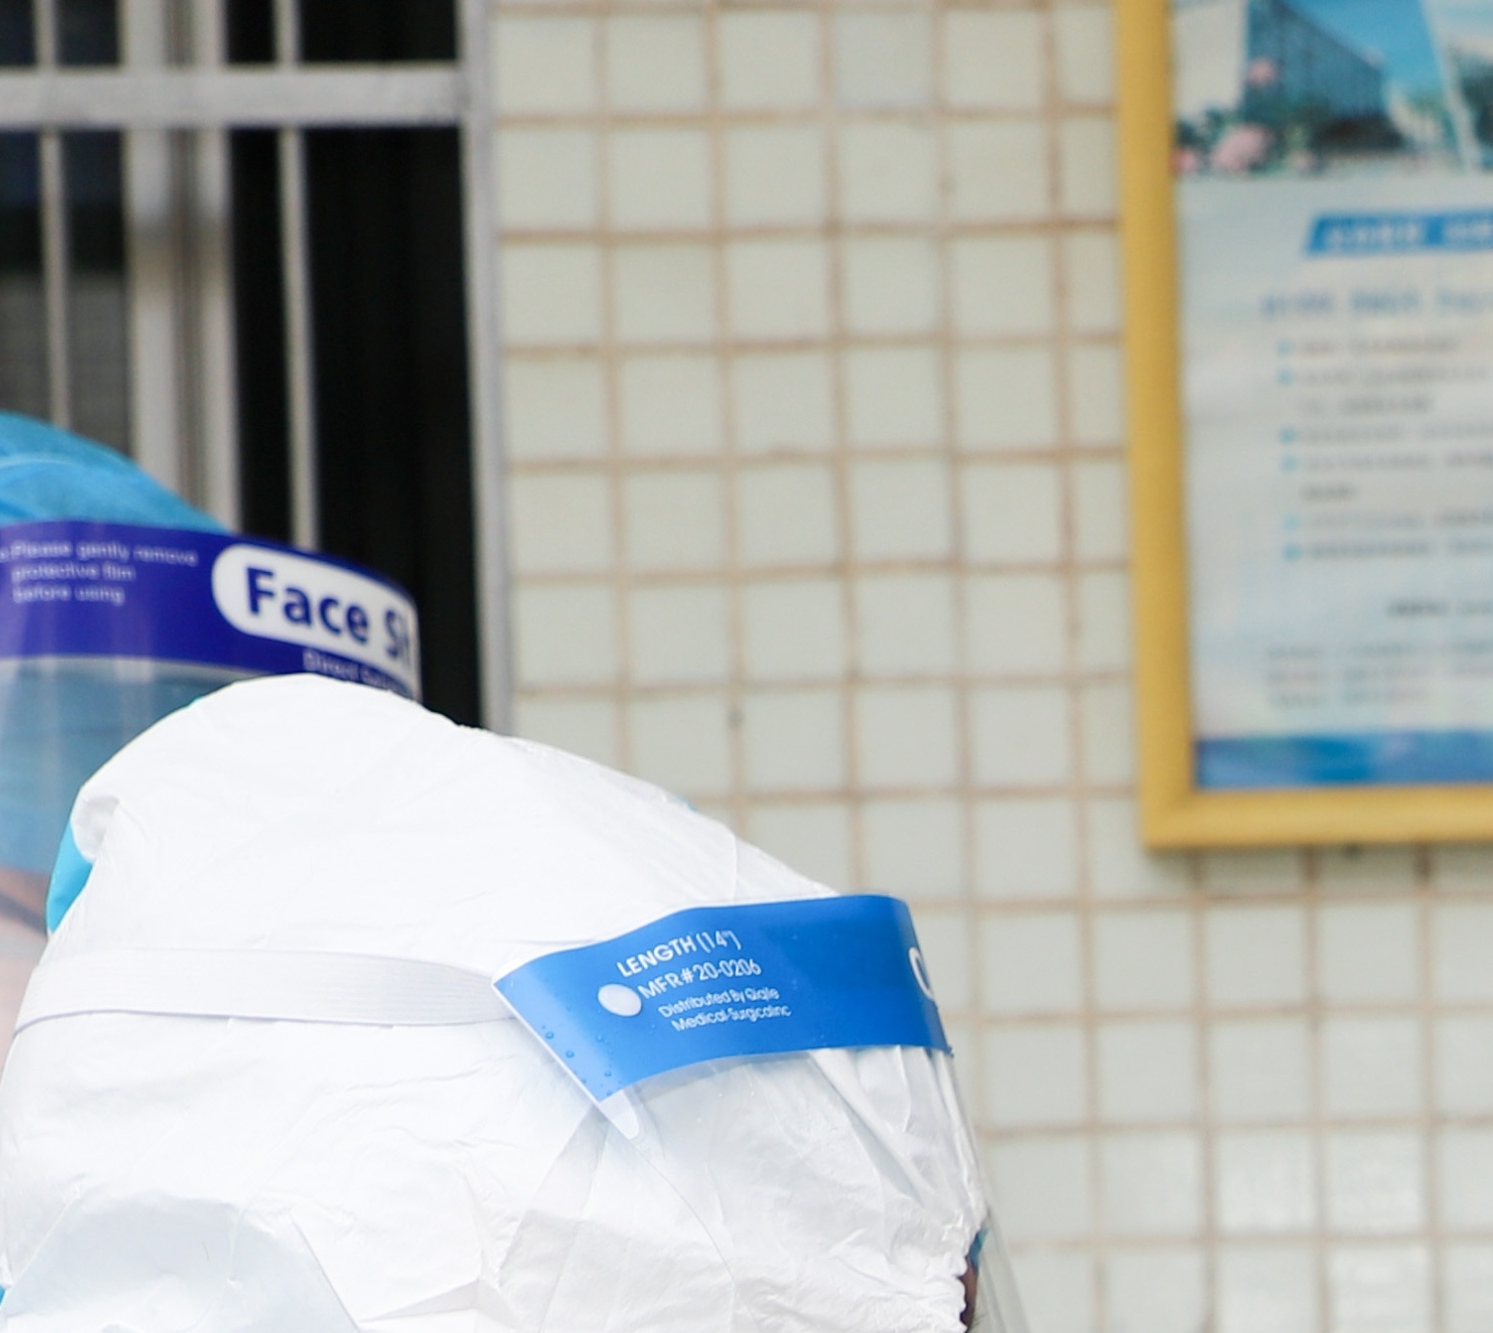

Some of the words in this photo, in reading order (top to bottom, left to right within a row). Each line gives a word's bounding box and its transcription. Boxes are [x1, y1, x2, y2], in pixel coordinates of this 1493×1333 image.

[246, 566, 369, 645] Face
[616, 936, 697, 977] LENGTH
[658, 990, 731, 1018] Distributed
